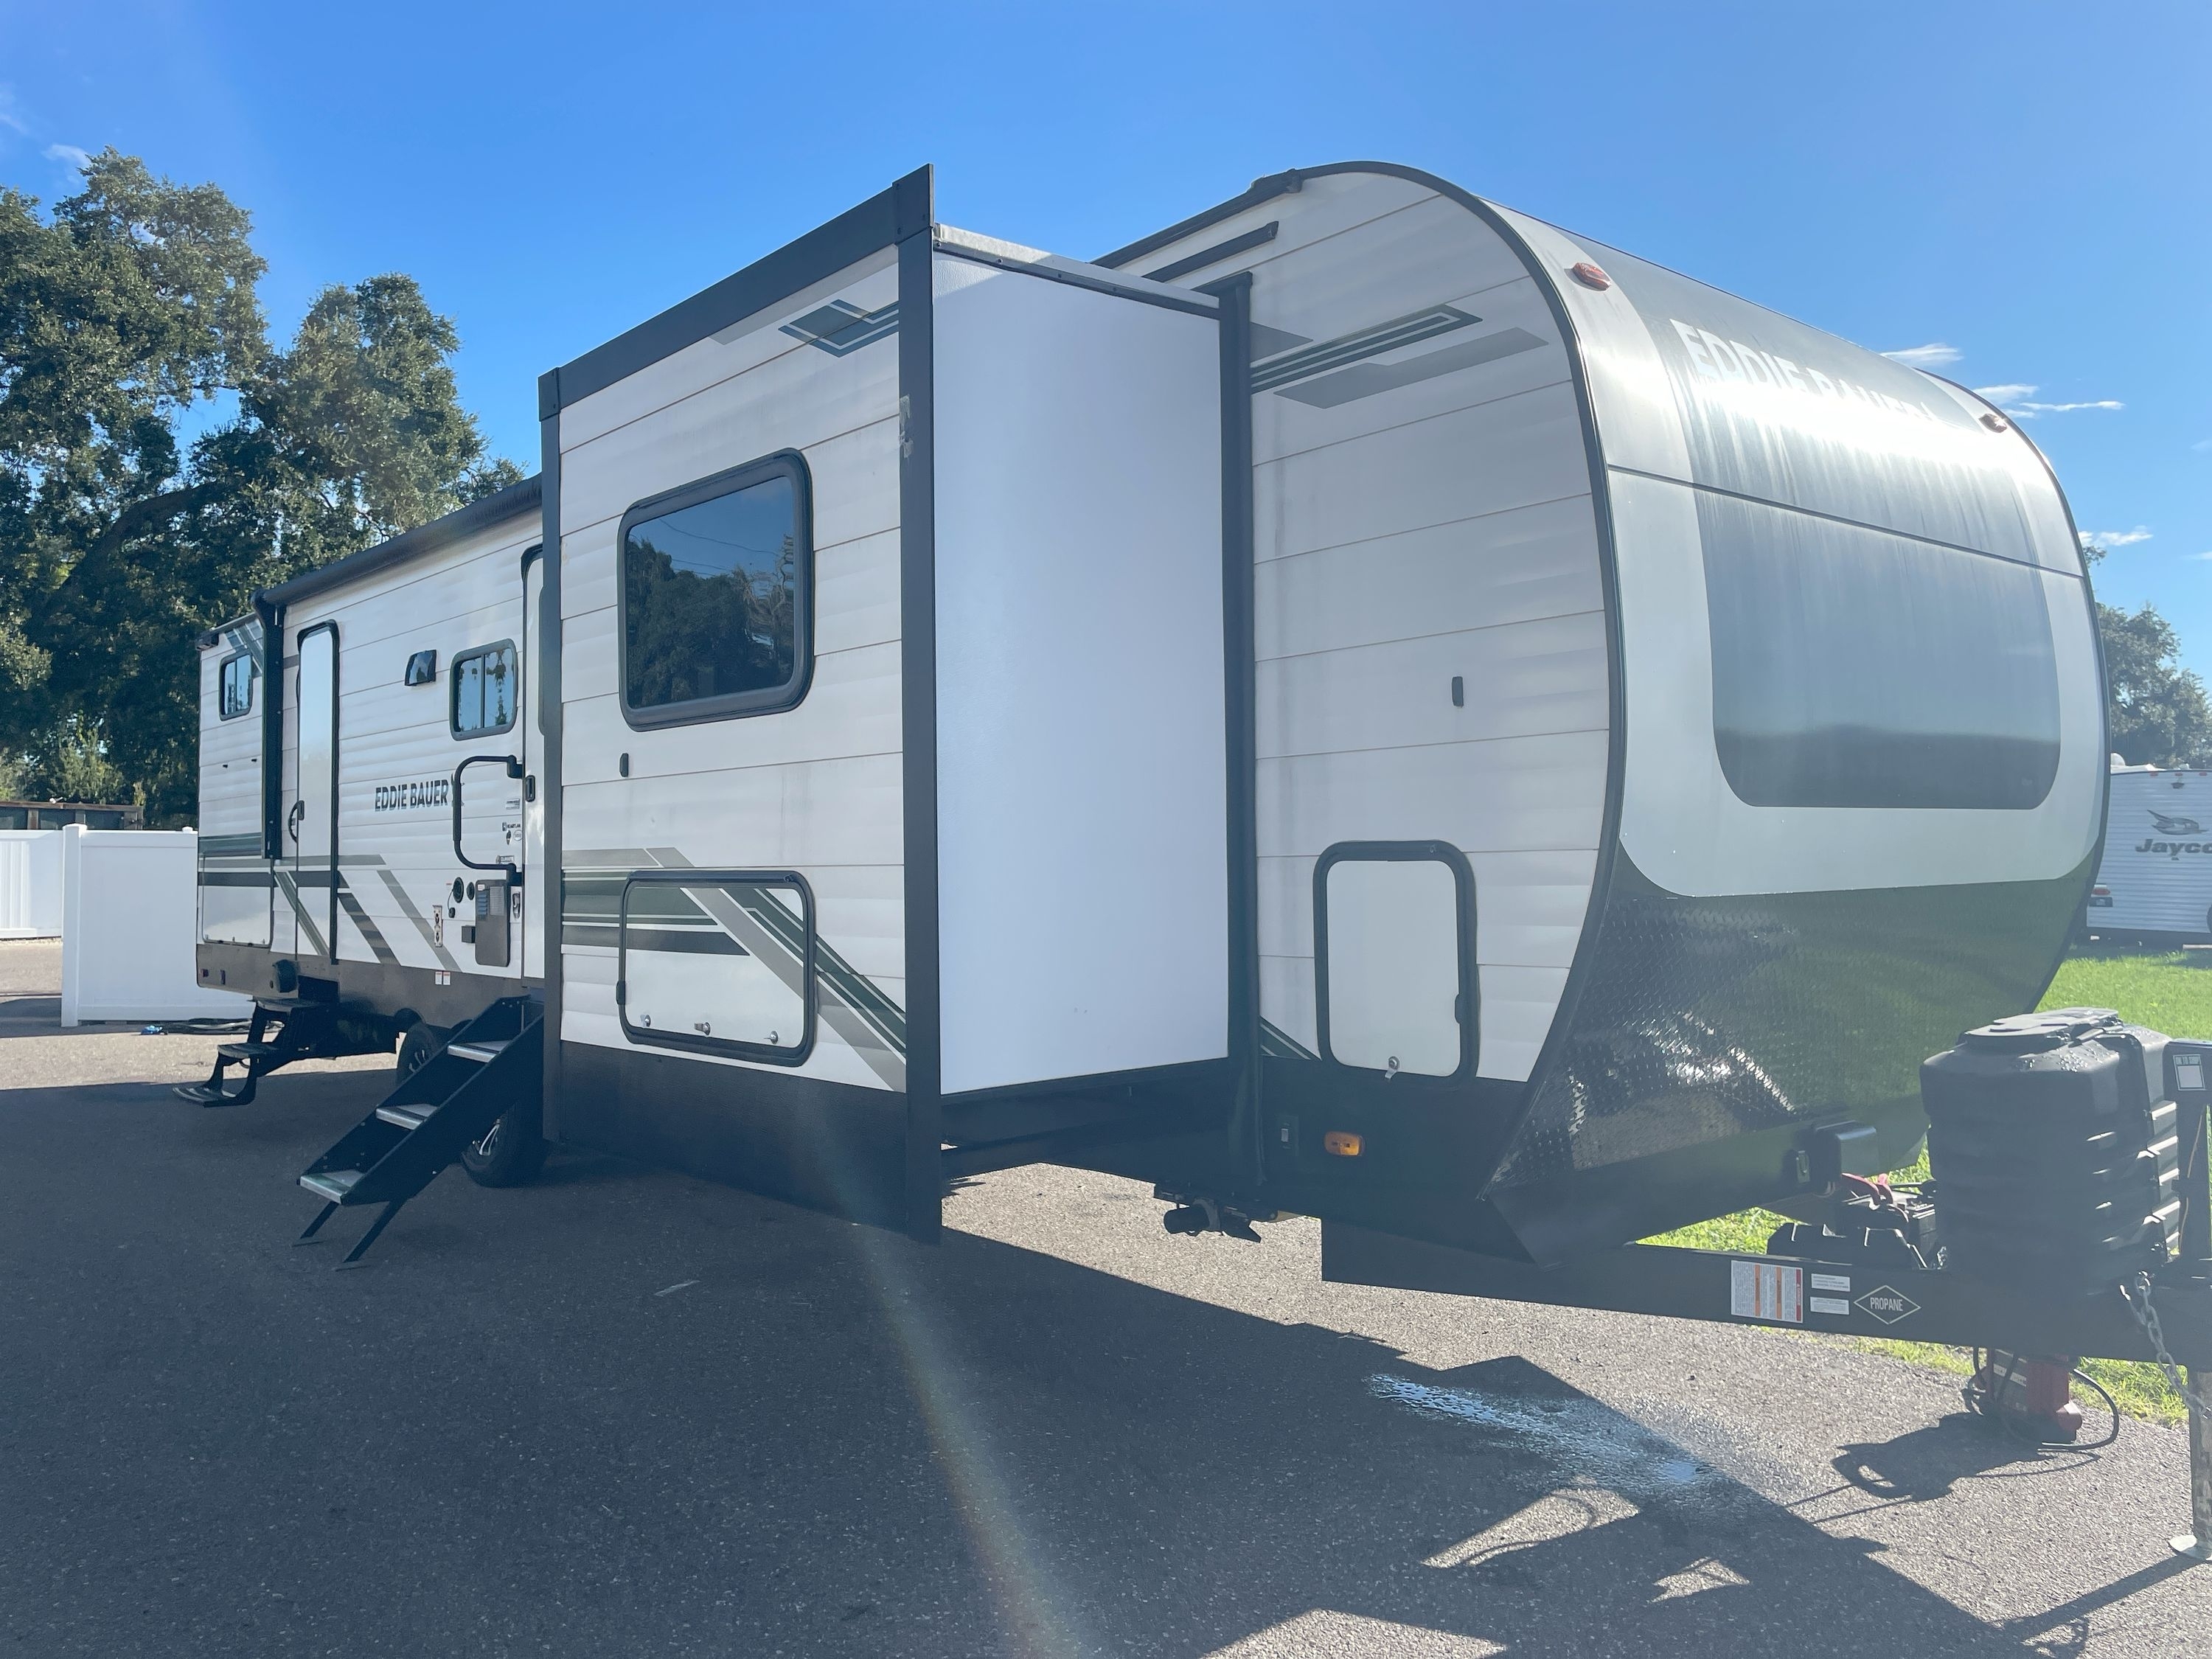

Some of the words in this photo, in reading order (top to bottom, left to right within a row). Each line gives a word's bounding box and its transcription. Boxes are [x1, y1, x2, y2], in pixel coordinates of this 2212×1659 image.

[1669, 319, 1814, 394] EDDIE
[375, 784, 407, 812] EDDIE
[409, 779, 449, 809] BAUER
[1870, 1297, 1904, 1312] PROPANE
